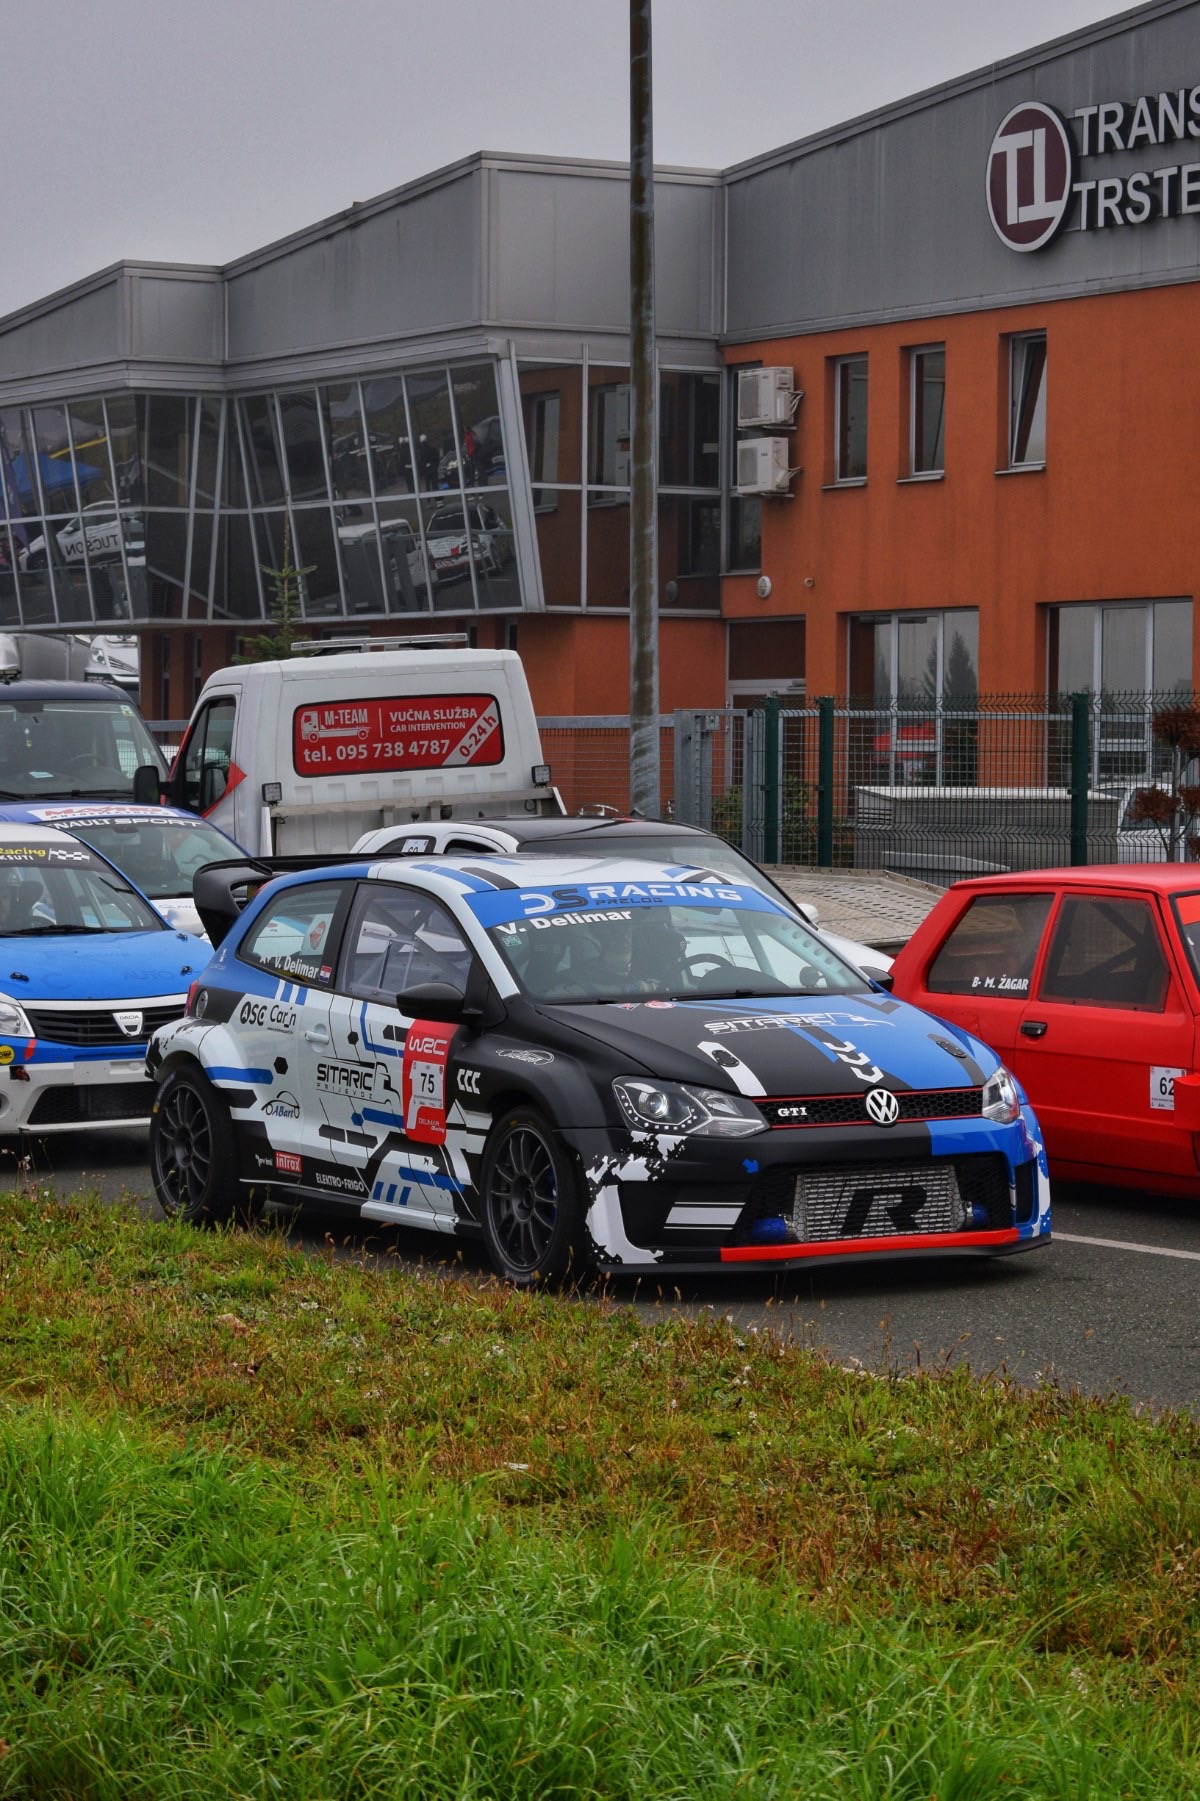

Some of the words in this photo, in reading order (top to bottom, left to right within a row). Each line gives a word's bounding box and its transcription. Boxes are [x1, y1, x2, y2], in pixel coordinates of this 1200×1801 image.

[1074, 84, 1200, 156] TRANS
[1072, 162, 1200, 231] TRSTE
[324, 709, 368, 725] M-TEAM
[389, 710, 430, 722] VUČNA
[433, 706, 478, 719] SLUŽBA
[390, 724, 406, 733] CAR
[408, 722, 465, 731] INTERVENTION
[459, 724, 487, 758] 0-24
[485, 714, 496, 726] h
[303, 746, 332, 763] tel.
[336, 744, 368, 760] 095
[372, 742, 404, 758] 738
[408, 739, 450, 756] 4787
[114, 818, 201, 827] SPORT
[588, 884, 742, 901] RACING
[595, 896, 664, 906] PRELOG
[496, 924, 526, 935] V.
[530, 909, 633, 930] Delimar
[274, 955, 282, 969] V.
[283, 955, 320, 979] Delimar
[984, 976, 996, 988] M.
[998, 974, 1029, 990] ŽAGAR
[703, 1016, 829, 1035] SITARIC
[409, 1035, 448, 1056] WRC
[316, 1063, 373, 1091] SITARIC
[420, 1073, 435, 1094] 75
[1160, 1077, 1174, 1095] 62
[316, 1082, 373, 1099] PRIJEVOZ
[777, 1106, 808, 1117] GTI
